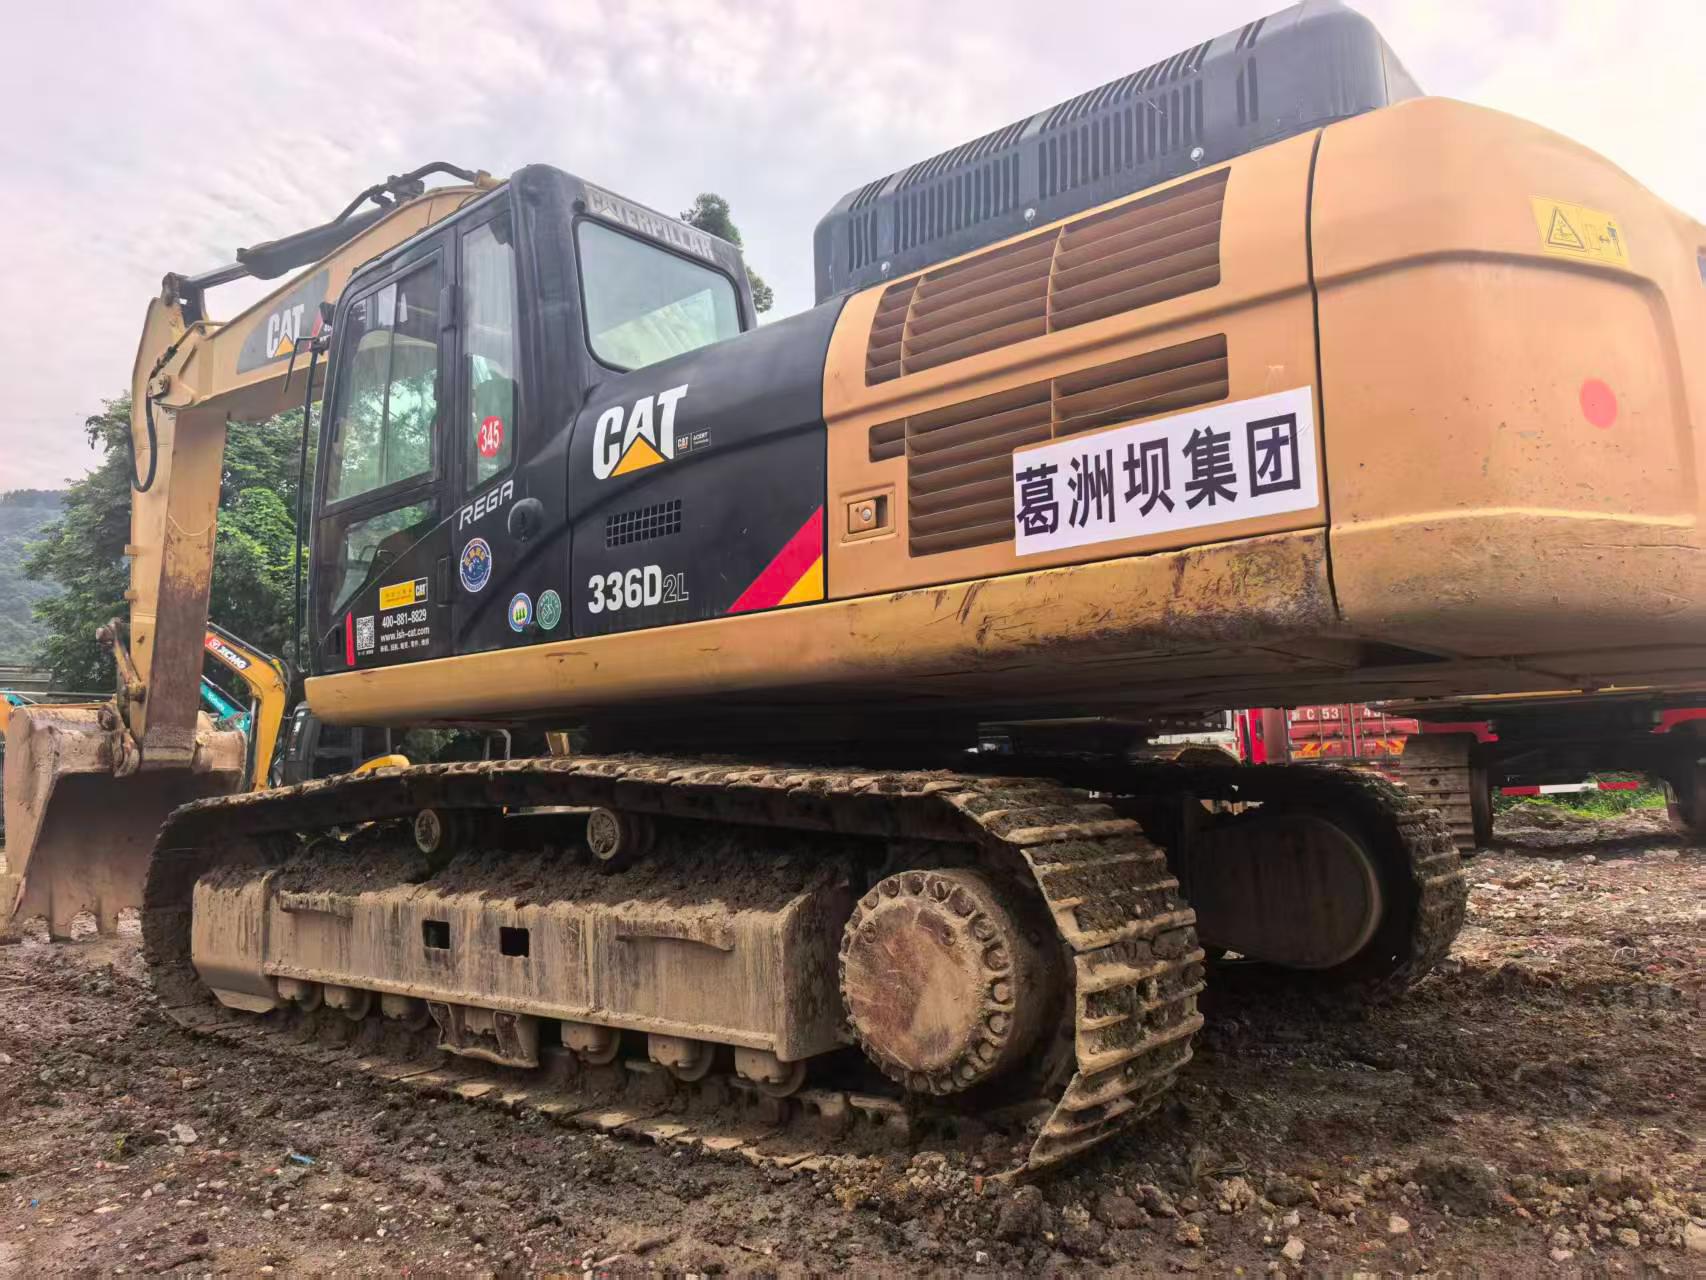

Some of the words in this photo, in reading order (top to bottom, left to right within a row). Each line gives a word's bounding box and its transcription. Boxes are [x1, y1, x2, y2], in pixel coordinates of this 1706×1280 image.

[266, 304, 304, 358] CAT
[481, 420, 500, 452] 345
[593, 384, 689, 480] CAT
[1016, 412, 1301, 536] 葛洲坝集团
[459, 480, 514, 531] REGA
[416, 584, 426, 596] CAT
[382, 609, 427, 627] 400-881-8829
